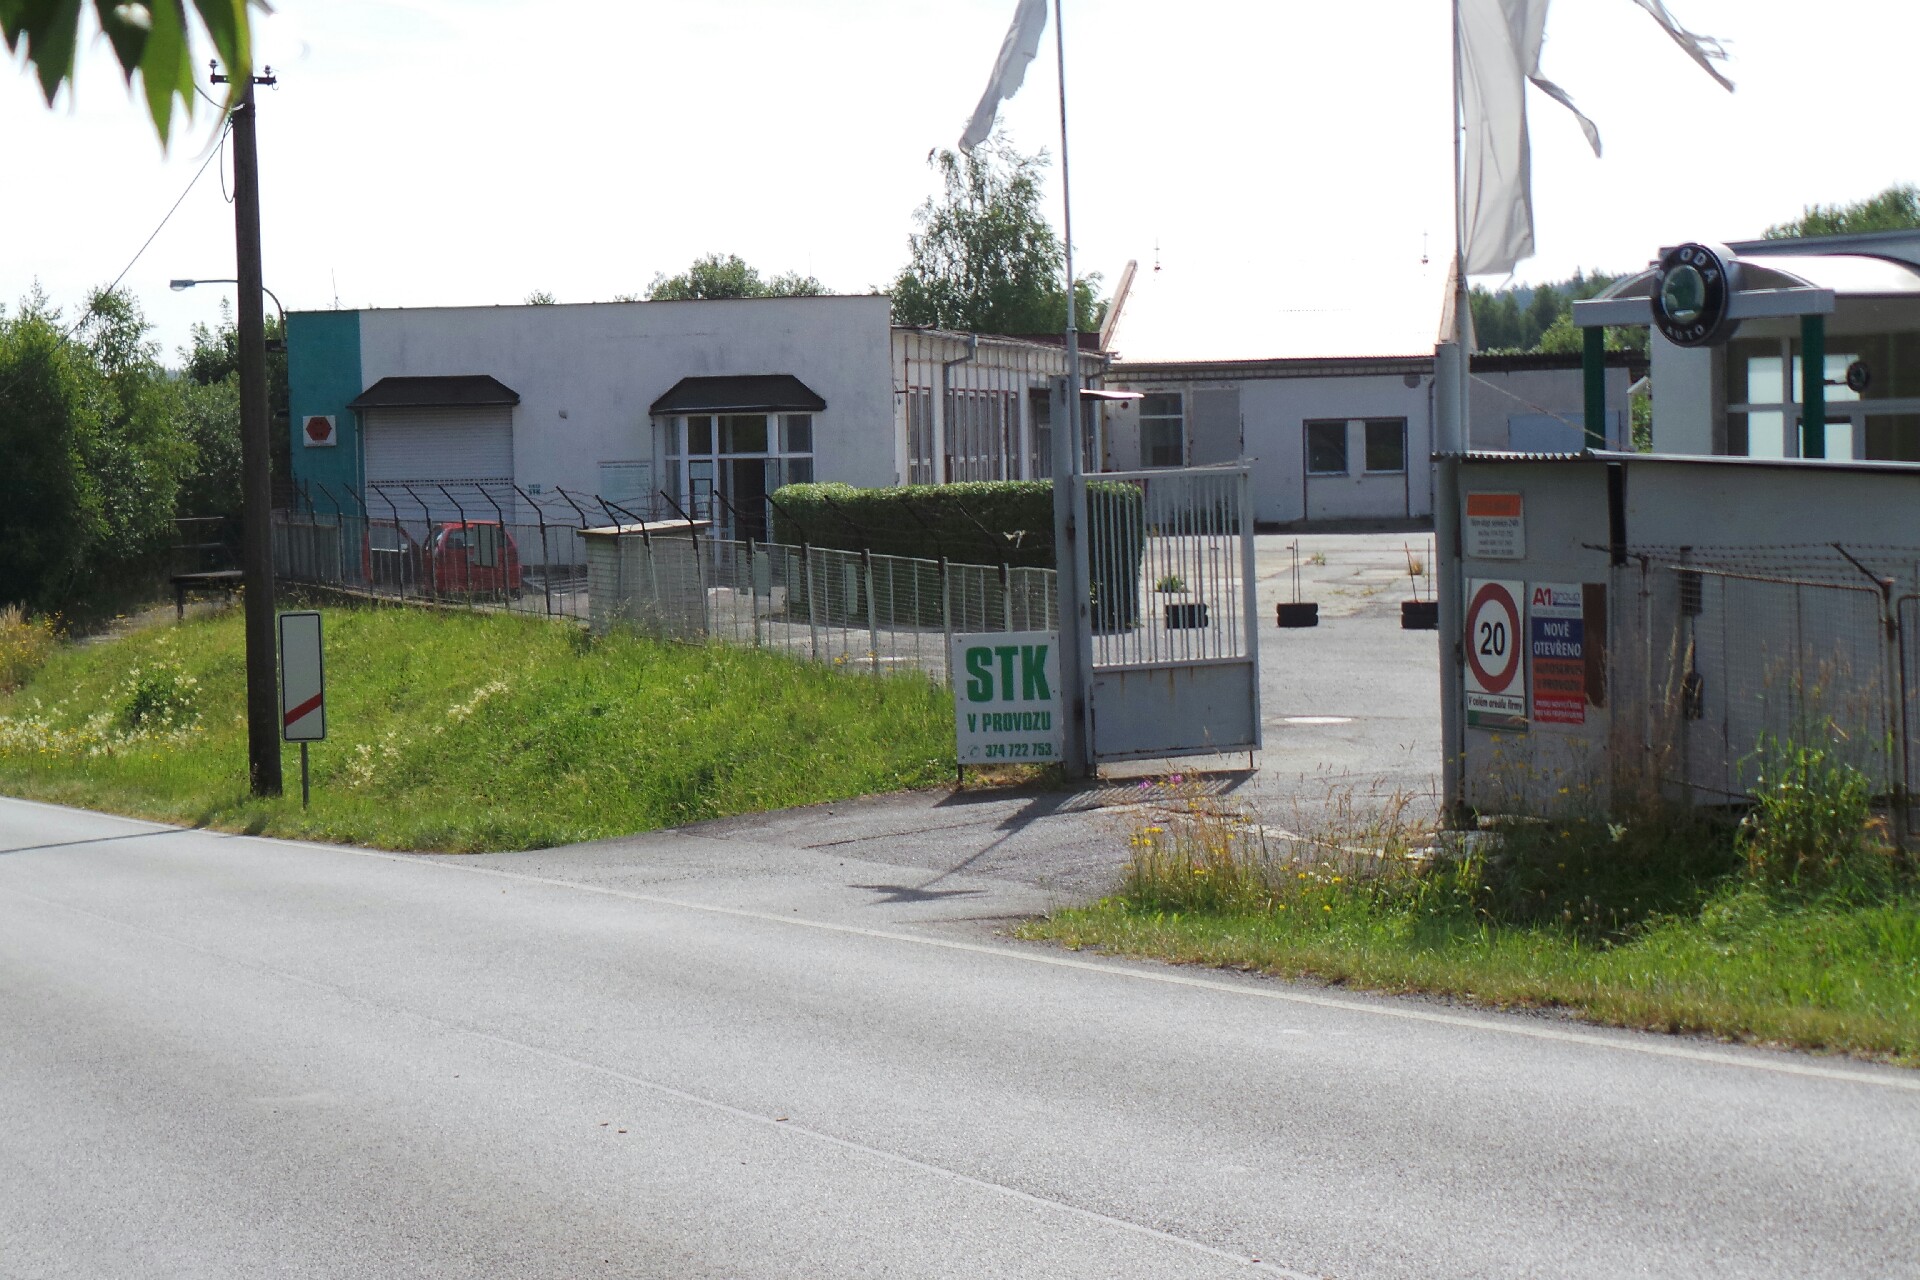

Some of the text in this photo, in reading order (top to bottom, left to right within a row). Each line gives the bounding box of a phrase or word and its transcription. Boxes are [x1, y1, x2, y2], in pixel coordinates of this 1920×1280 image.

[1665, 324, 1704, 341] AUTO
[1533, 587, 1552, 606] A1
[1481, 621, 1505, 656] 20
[1534, 639, 1581, 657] OTEVŘENO
[966, 645, 1051, 702] STK
[1507, 699, 1523, 713] firmy
[967, 711, 1051, 733] V PROVOZU
[985, 742, 1052, 758] 374 722 753
